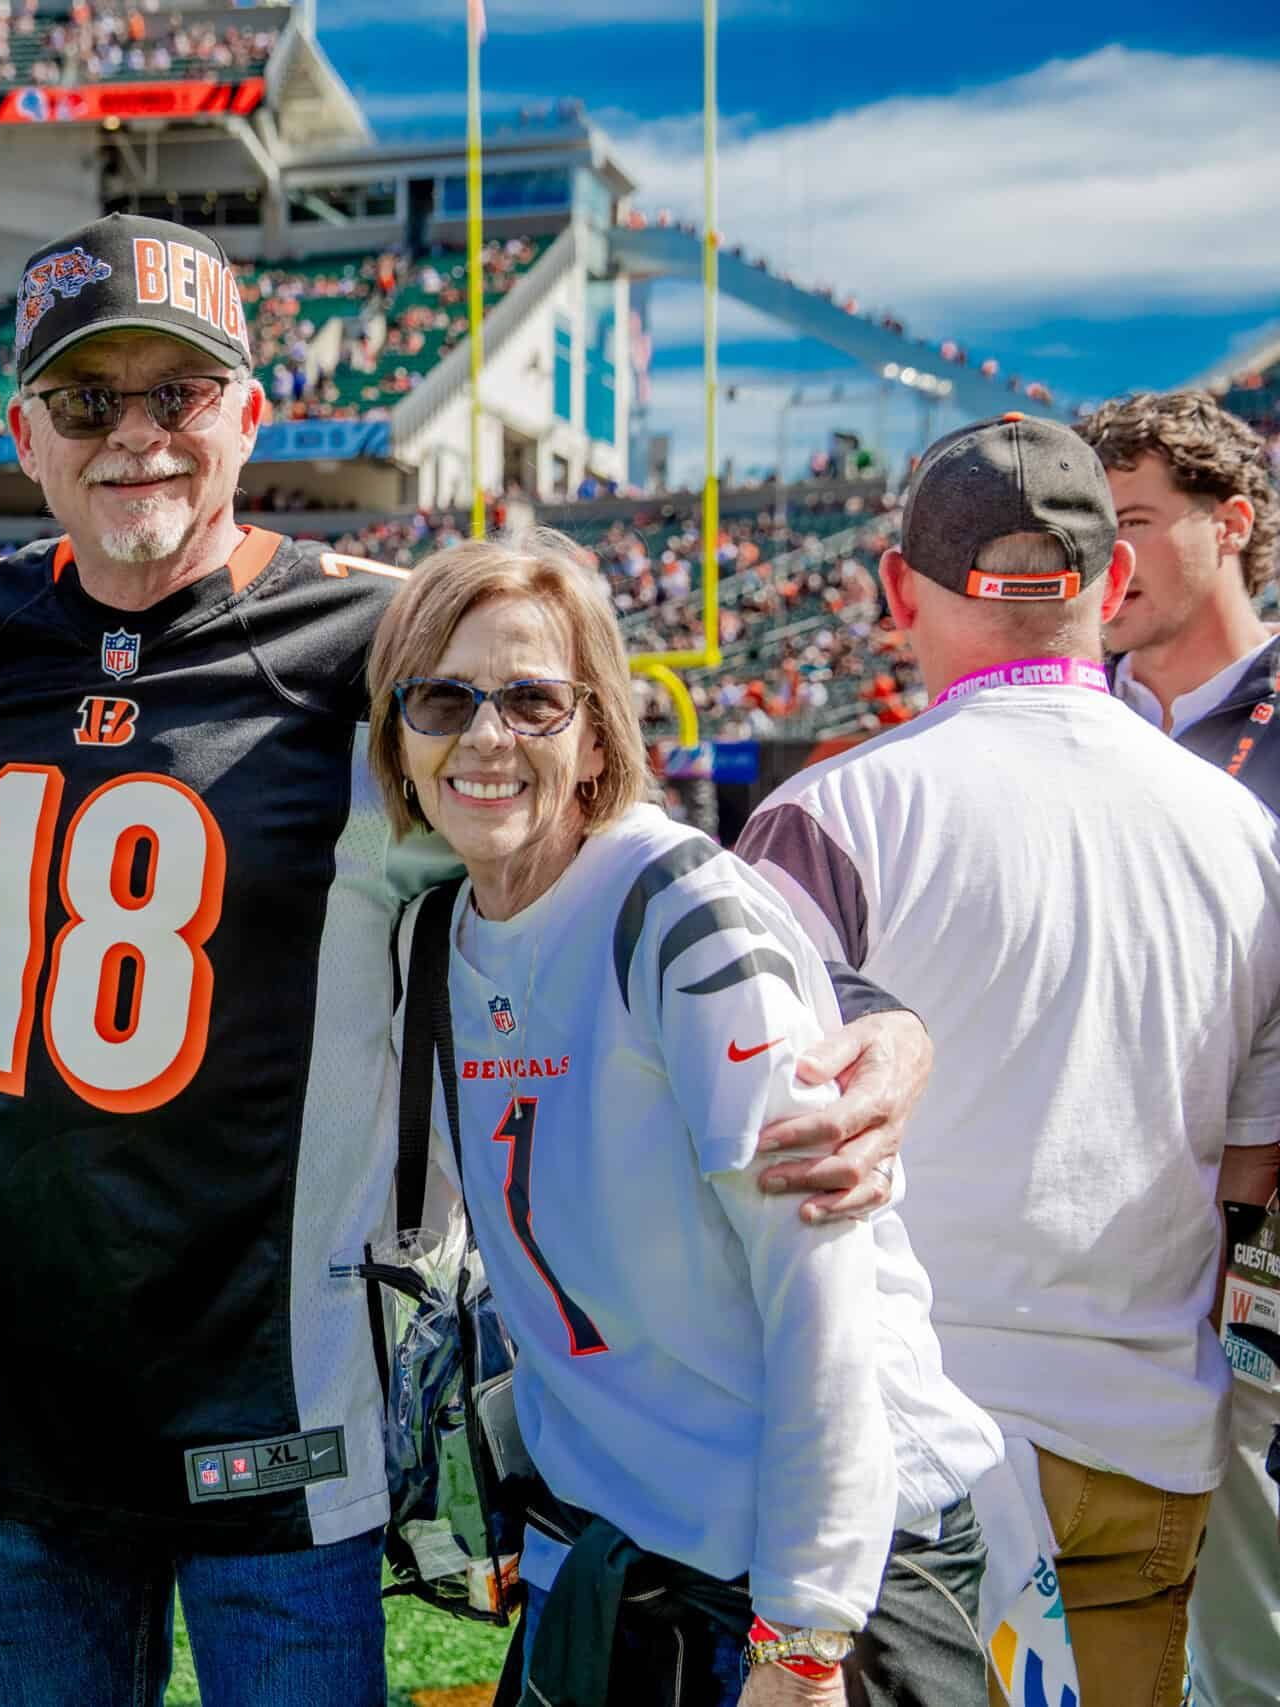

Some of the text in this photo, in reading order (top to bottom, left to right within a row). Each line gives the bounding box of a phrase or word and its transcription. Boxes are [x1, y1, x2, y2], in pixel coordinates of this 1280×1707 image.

[132, 238, 251, 357] BENG
[106, 649, 132, 672] NFL
[948, 671, 1010, 700] CRUCIAL
[1011, 664, 1064, 685] CATCH
[493, 1012, 514, 1031] NFL
[462, 1055, 570, 1080] BENGALS
[492, 1096, 609, 1357] 1
[1234, 1242, 1268, 1271] GUEST
[1231, 1290, 1253, 1326] W
[265, 1443, 299, 1466] XL
